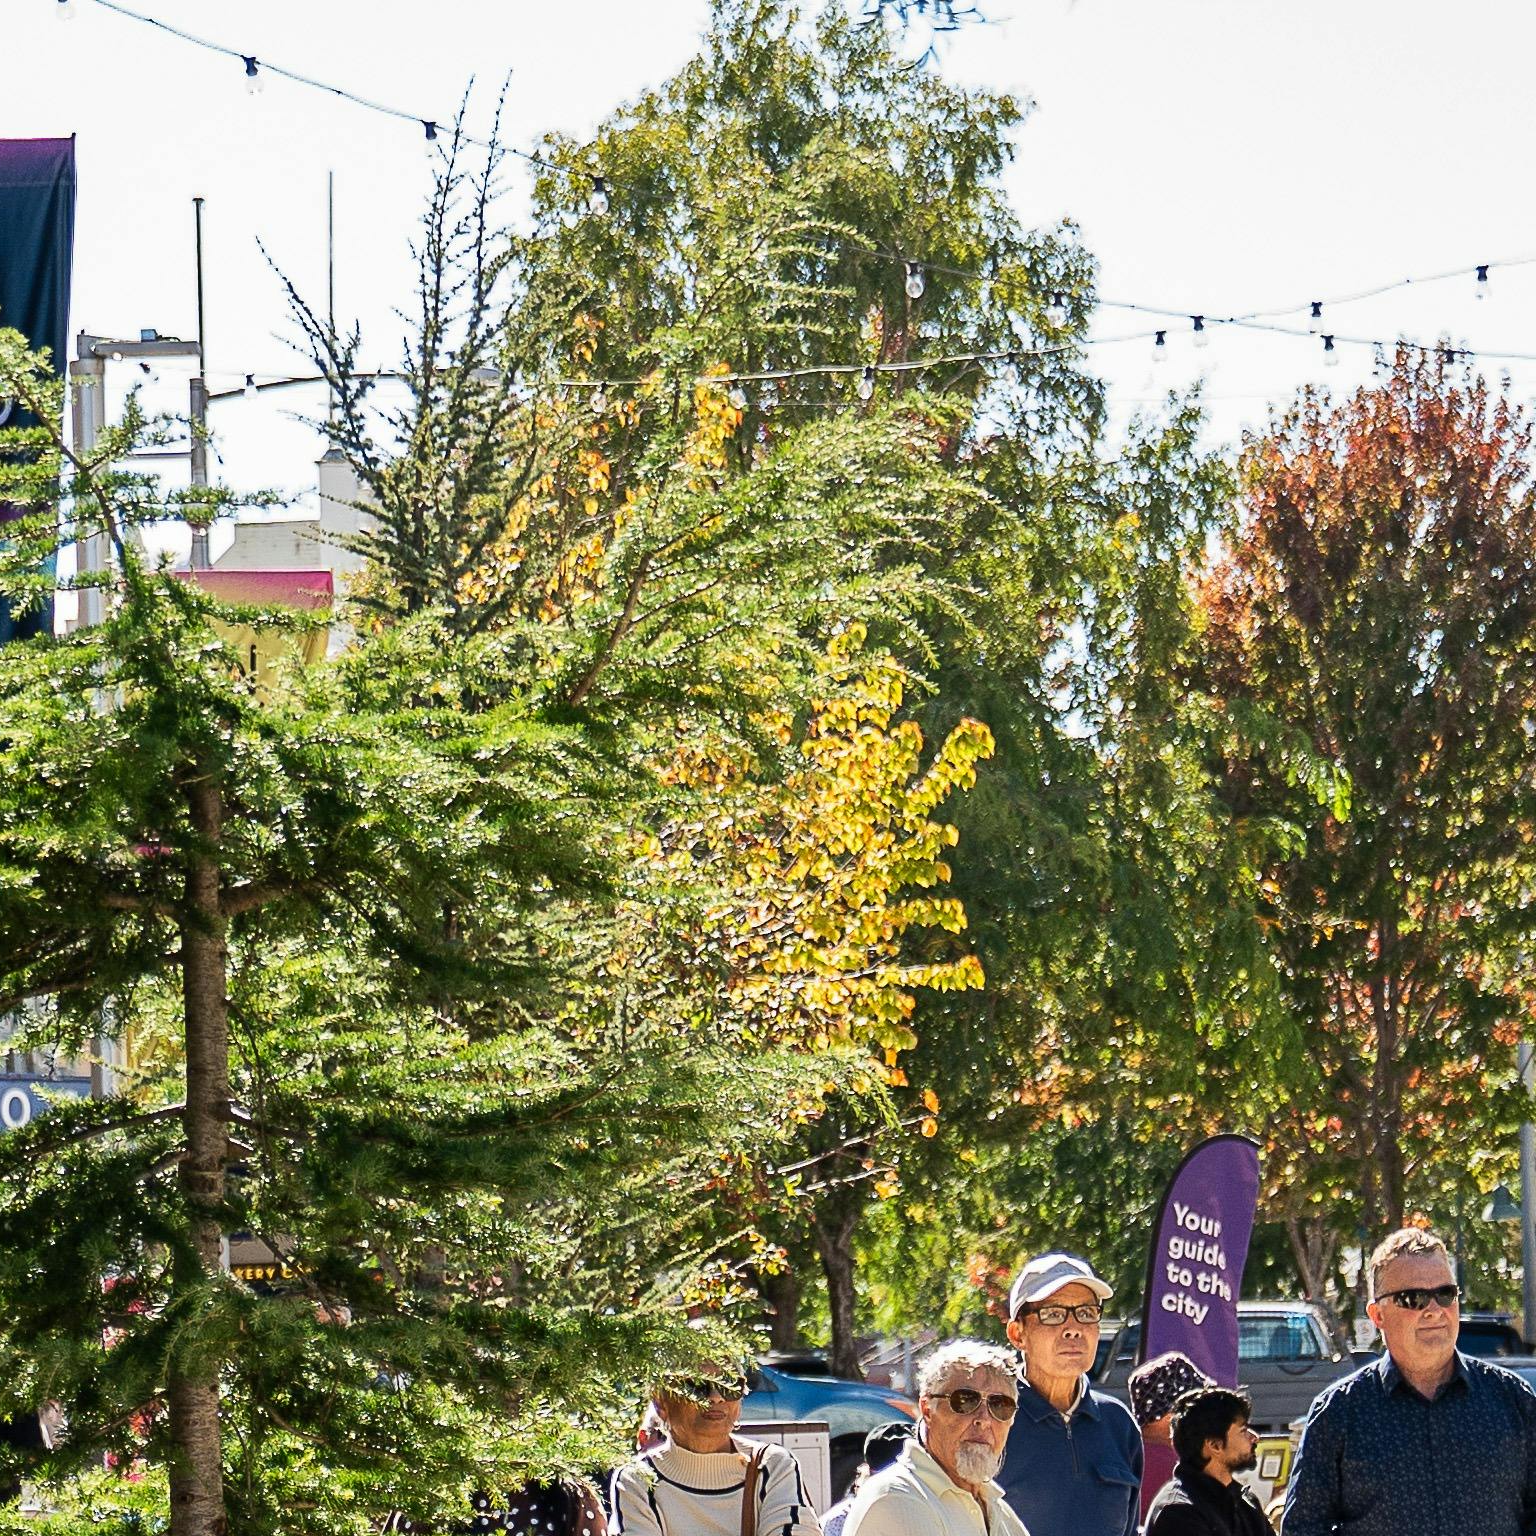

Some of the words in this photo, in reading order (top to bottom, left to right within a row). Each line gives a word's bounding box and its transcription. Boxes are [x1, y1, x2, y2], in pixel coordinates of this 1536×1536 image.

[1173, 1201, 1222, 1238] Your
[1168, 1236, 1227, 1270] guide
[1166, 1262, 1193, 1287] to
[1196, 1271, 1232, 1302] the
[1161, 1291, 1209, 1325] city
